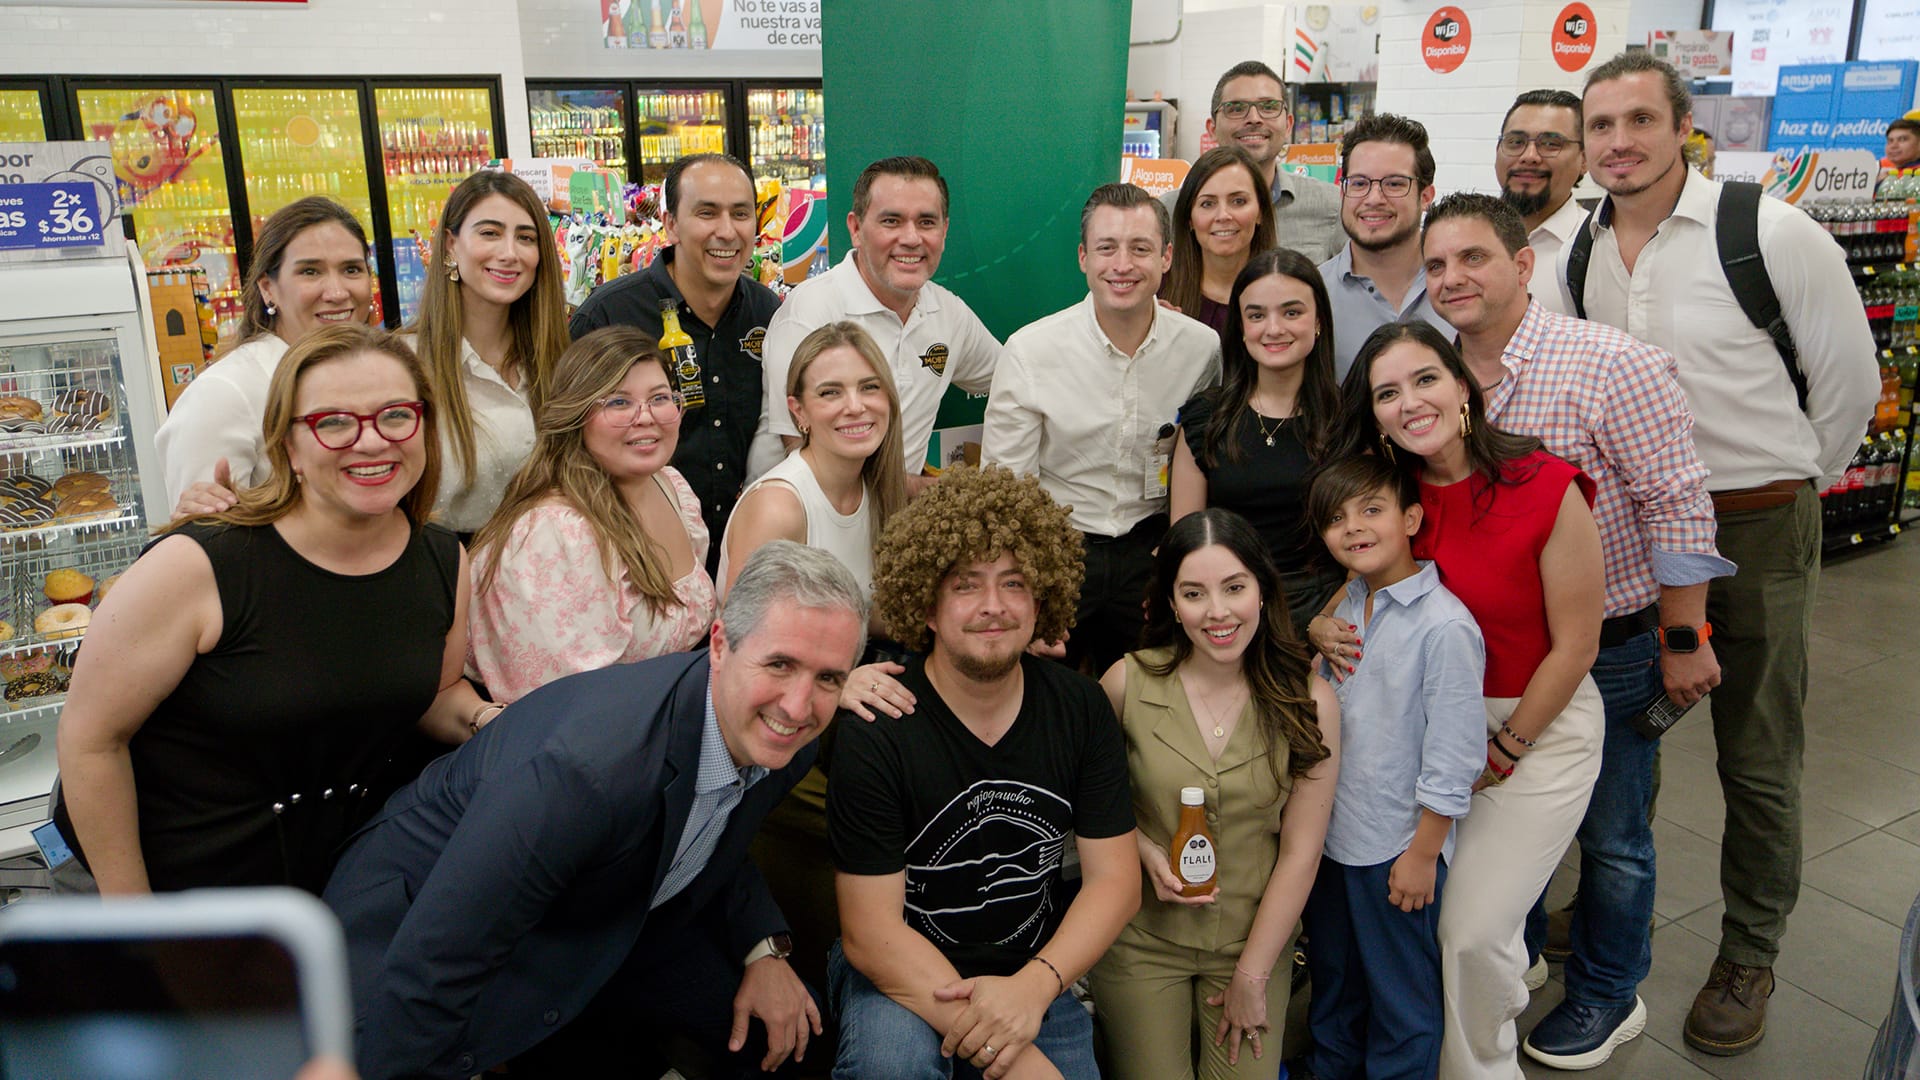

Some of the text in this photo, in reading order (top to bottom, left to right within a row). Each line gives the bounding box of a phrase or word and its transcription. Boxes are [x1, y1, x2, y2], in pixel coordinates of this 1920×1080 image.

[733, 0, 819, 13] No te vas a
[741, 15, 801, 29] nuestra
[767, 30, 788, 45] de
[1426, 45, 1466, 57] Disponible
[1555, 42, 1592, 55] Disponible
[1780, 74, 1832, 87] amazon
[1778, 118, 1889, 139] haz tu pedido
[1155, 172, 1174, 184] para
[1815, 167, 1869, 192] Oferta
[67, 234, 87, 242] hasta
